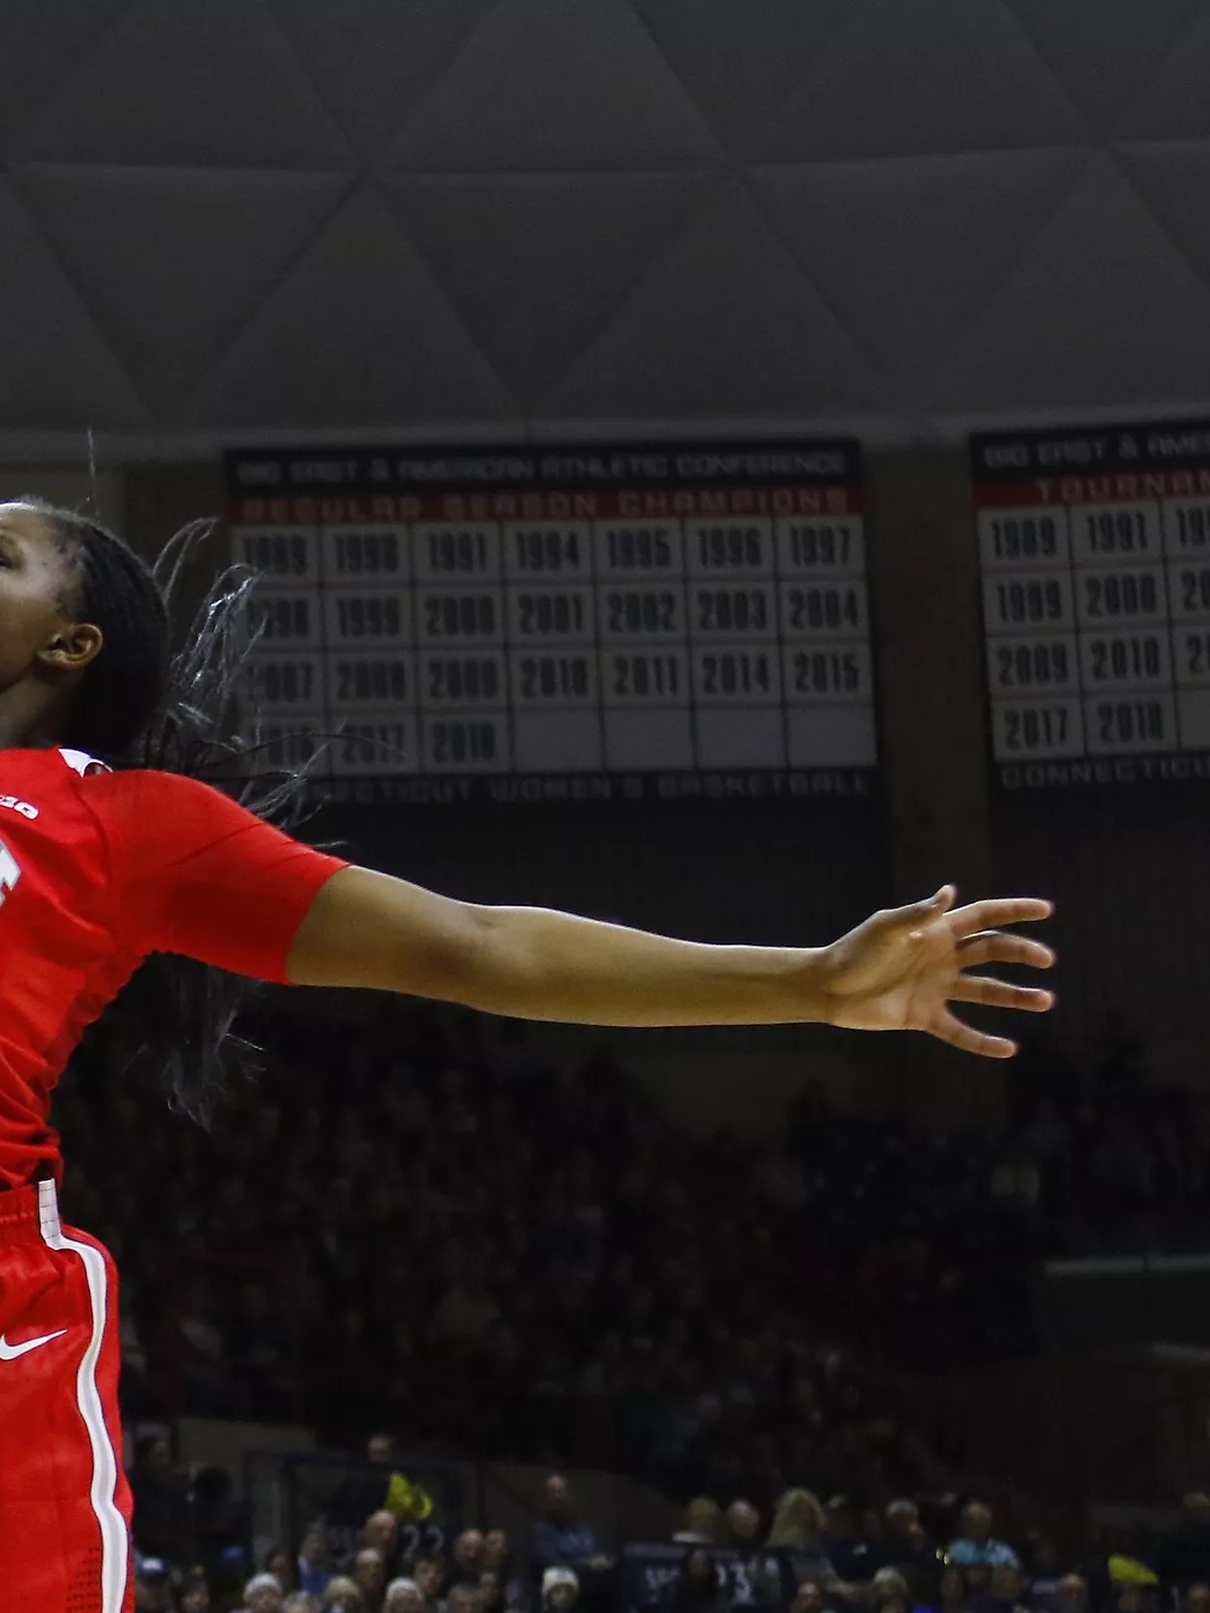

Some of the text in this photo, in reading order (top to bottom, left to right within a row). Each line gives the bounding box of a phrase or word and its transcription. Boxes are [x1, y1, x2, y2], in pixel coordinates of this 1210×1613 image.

[369, 457, 392, 481] &
[398, 456, 535, 481] AMERICAN
[541, 453, 668, 479] ATHLETIC
[676, 451, 846, 477] CONFERENCE
[1119, 433, 1138, 460] &
[242, 487, 849, 522] REGULAR SEASON CHAMPIONS
[429, 531, 488, 572] 1991
[517, 530, 579, 570] 1994
[607, 529, 671, 569] 1995
[698, 527, 761, 568] 1996
[791, 525, 850, 567] 1997
[1087, 509, 1146, 551] 1991
[337, 598, 399, 637] 1999
[425, 595, 494, 636] 2000
[518, 594, 582, 635] 2001
[607, 592, 676, 633] 2002
[699, 590, 766, 631] 2003
[790, 588, 859, 630] 2004
[1085, 572, 1156, 617] 2000
[521, 658, 588, 698] 2010
[613, 655, 678, 696] 2011
[702, 654, 769, 695] 2014
[795, 652, 860, 693] 2015
[1090, 635, 1161, 680] 2010
[1003, 705, 1068, 750] 2017
[657, 771, 871, 799] BASKETBALL
